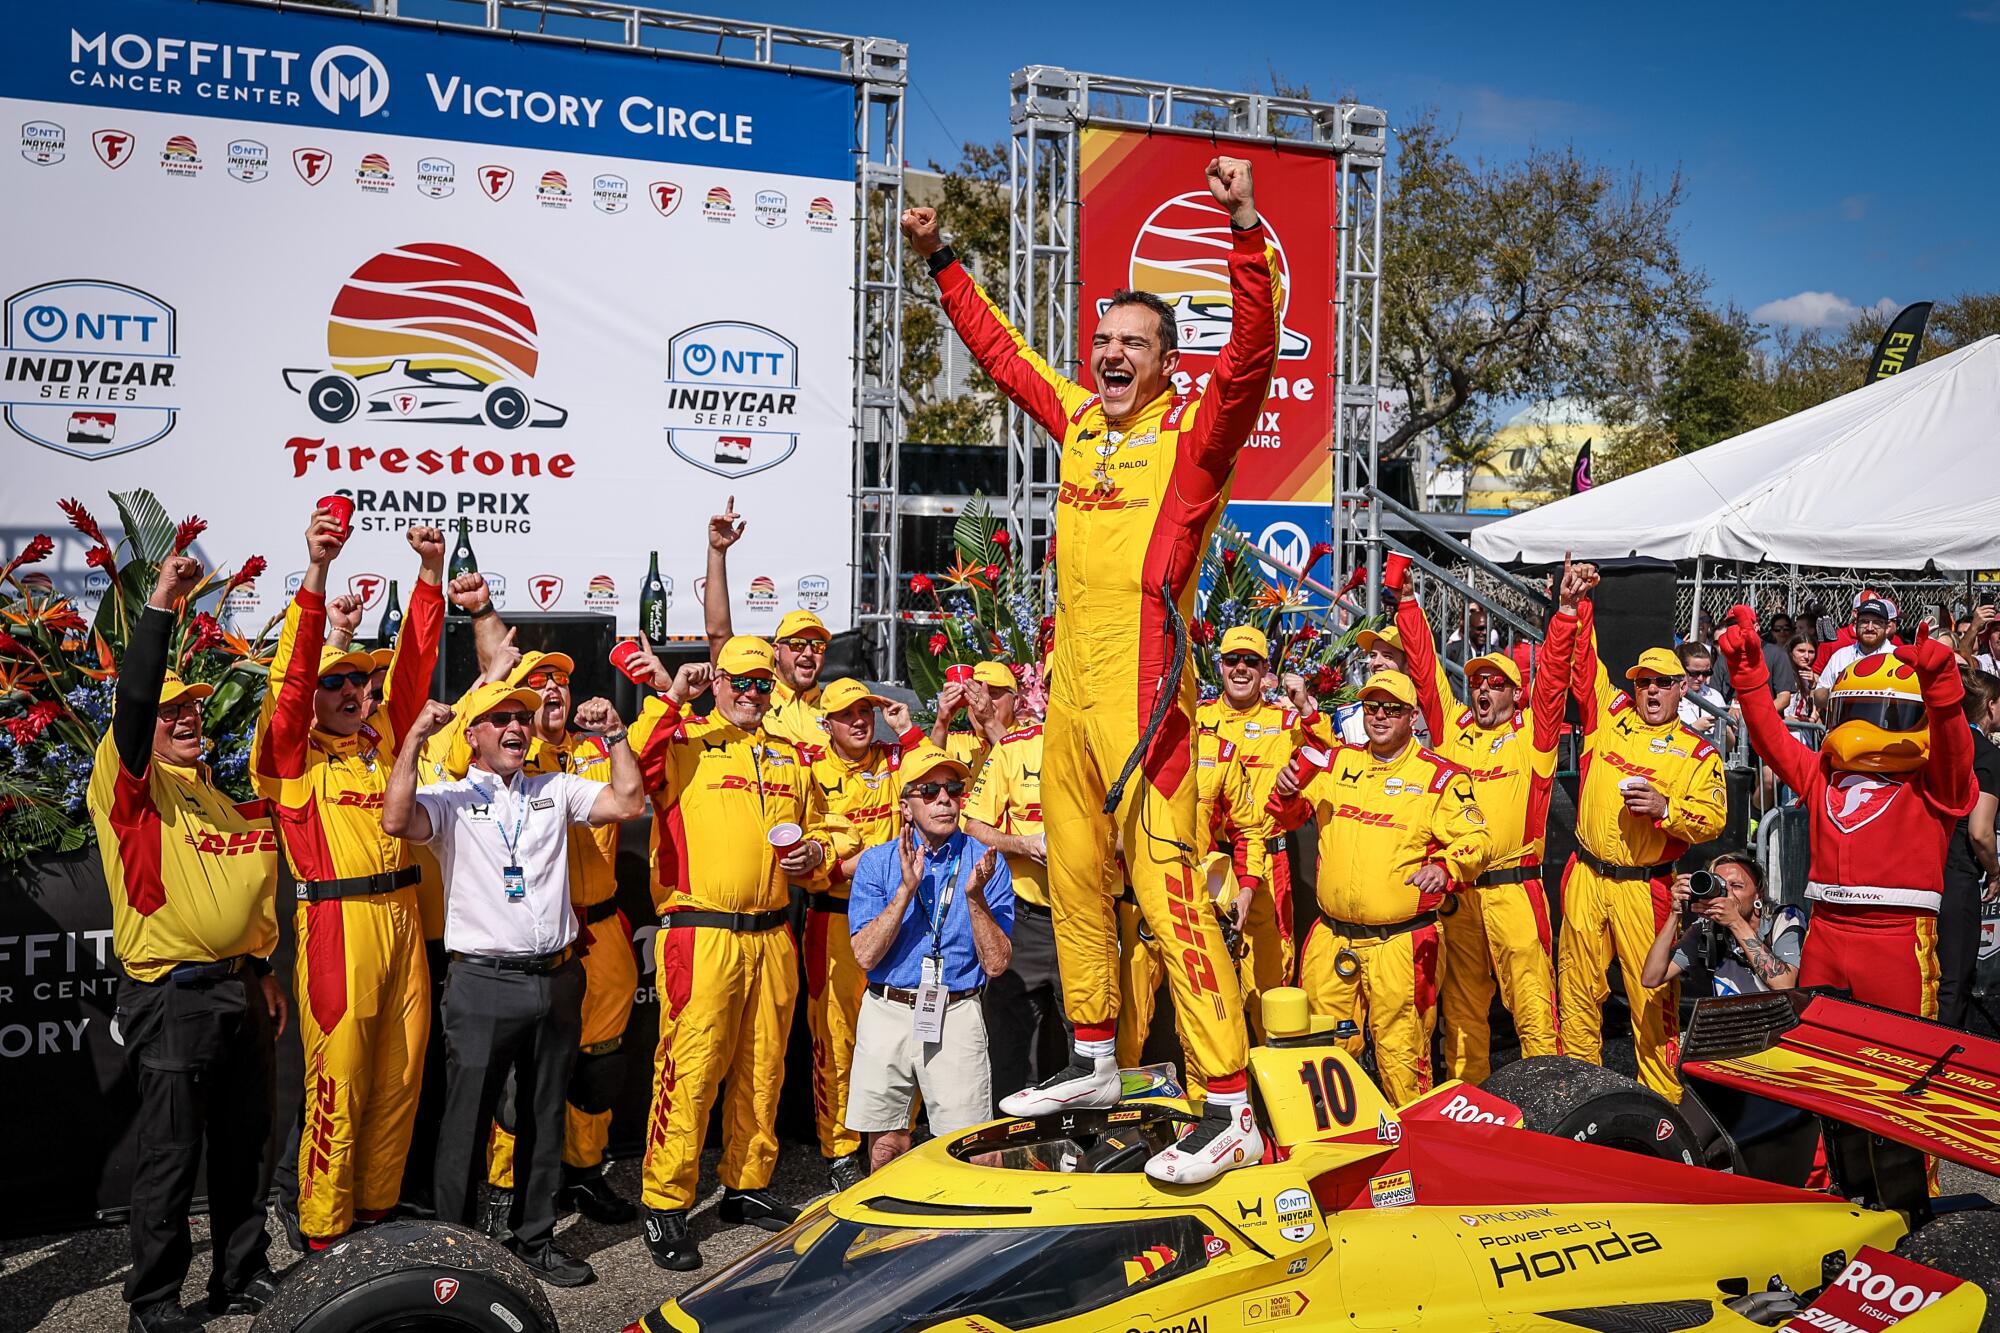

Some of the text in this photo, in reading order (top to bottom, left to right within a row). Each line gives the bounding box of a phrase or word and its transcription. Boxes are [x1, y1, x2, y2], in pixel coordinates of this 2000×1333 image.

[71, 27, 300, 85] MOFFITT
[70, 69, 300, 107] CANCER CENTER
[39, 129, 61, 138] NTT
[22, 139, 65, 149] INDYCAR
[243, 148, 263, 156] NTT
[160, 161, 203, 170] Firestone
[228, 157, 268, 166] INDYCAR
[432, 164, 450, 173] NTT
[355, 179, 395, 187] Firestone
[417, 174, 454, 183] INDYCAR
[605, 181, 624, 189] NTT
[536, 194, 573, 203] Firestone
[594, 191, 627, 199] INDYCAR
[767, 196, 784, 205] NTT
[755, 206, 786, 214] INDYCAR
[76, 313, 158, 343] NTT
[721, 351, 784, 376] NTT
[5, 356, 175, 387] INDYCAR
[40, 384, 137, 402] SERIES
[668, 388, 796, 415] INDYCAR
[695, 412, 768, 428] SERIES
[1255, 412, 1281, 432] IX
[284, 435, 576, 479] Firestone
[1119, 459, 1148, 471] PALOU
[457, 491, 530, 516] PRIX
[362, 516, 531, 534] ST. PETERSBURG
[1834, 690, 1896, 698] FIREHAWK
[1603, 751, 1660, 783] DHL
[337, 790, 384, 809] DH
[1334, 804, 1396, 829] DHL
[1825, 888, 1882, 901] FIREHAWK
[1164, 864, 1219, 996] DHL
[1864, 1047, 1995, 1090] ACCELEATING
[1300, 1057, 1356, 1131] 10
[1113, 1112, 1137, 1120] DHL
[1012, 1122, 1031, 1132] DHL
[1883, 1114, 1937, 1138] Sarah
[1208, 1135, 1233, 1158] sparco
[1376, 1176, 1406, 1190] DHL
[1381, 1187, 1413, 1200] GANASSI
[1289, 1196, 1307, 1207] NTT
[1278, 1209, 1313, 1223] INDYCAR
[1238, 1220, 1267, 1229] Honda
[1479, 1218, 1612, 1249] Powered by
[1289, 1259, 1308, 1273] PPG
[1489, 1231, 1663, 1289] Honda
[1270, 1296, 1290, 1306] 100%
[492, 1304, 521, 1331] ENLITEN
[1271, 1308, 1291, 1318] RACE FUEL
[1799, 1307, 1867, 1333] SUN
[1125, 1316, 1208, 1333] enAI
